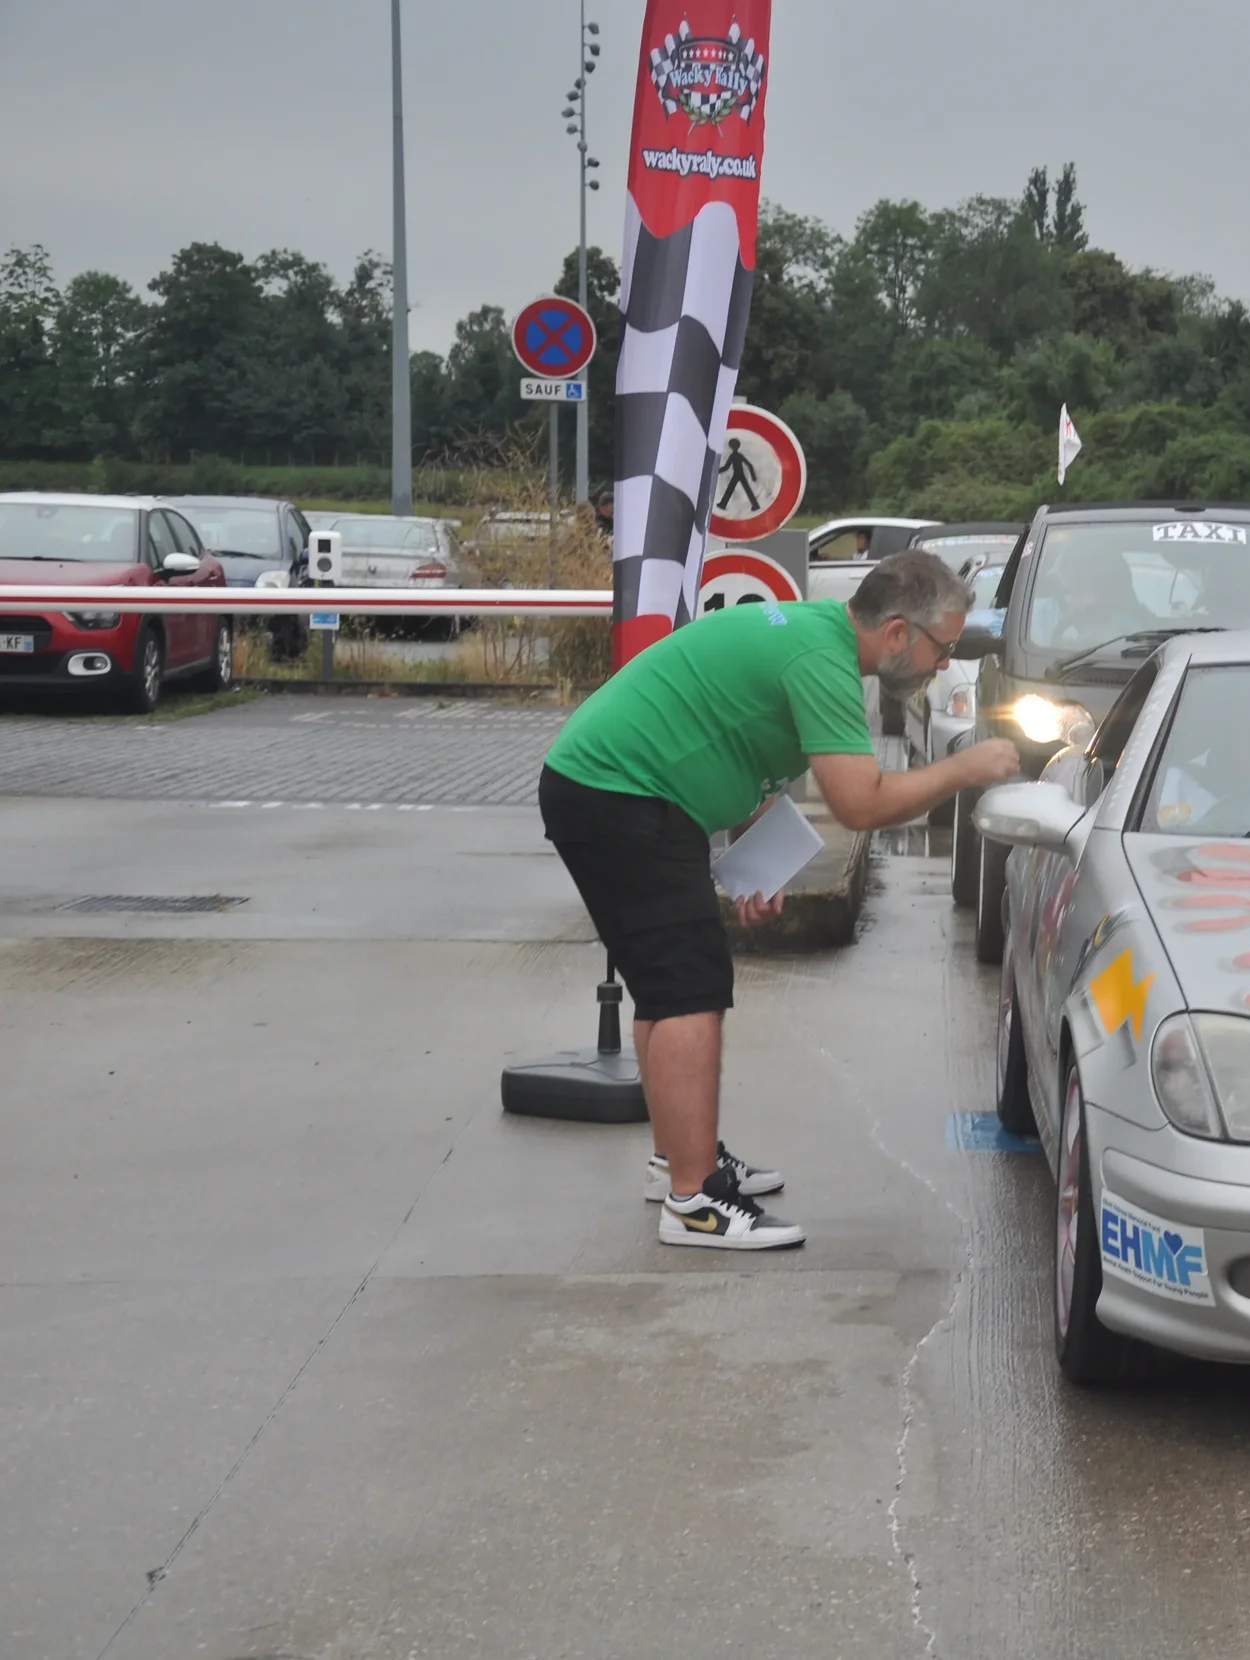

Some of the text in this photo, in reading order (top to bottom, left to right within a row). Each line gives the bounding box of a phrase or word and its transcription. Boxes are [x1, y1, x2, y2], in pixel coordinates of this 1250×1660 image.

[669, 64, 714, 88] Wacky
[525, 383, 562, 396] SAUF
[1156, 522, 1242, 541] TAXI
[1102, 1208, 1203, 1286] EHMF
